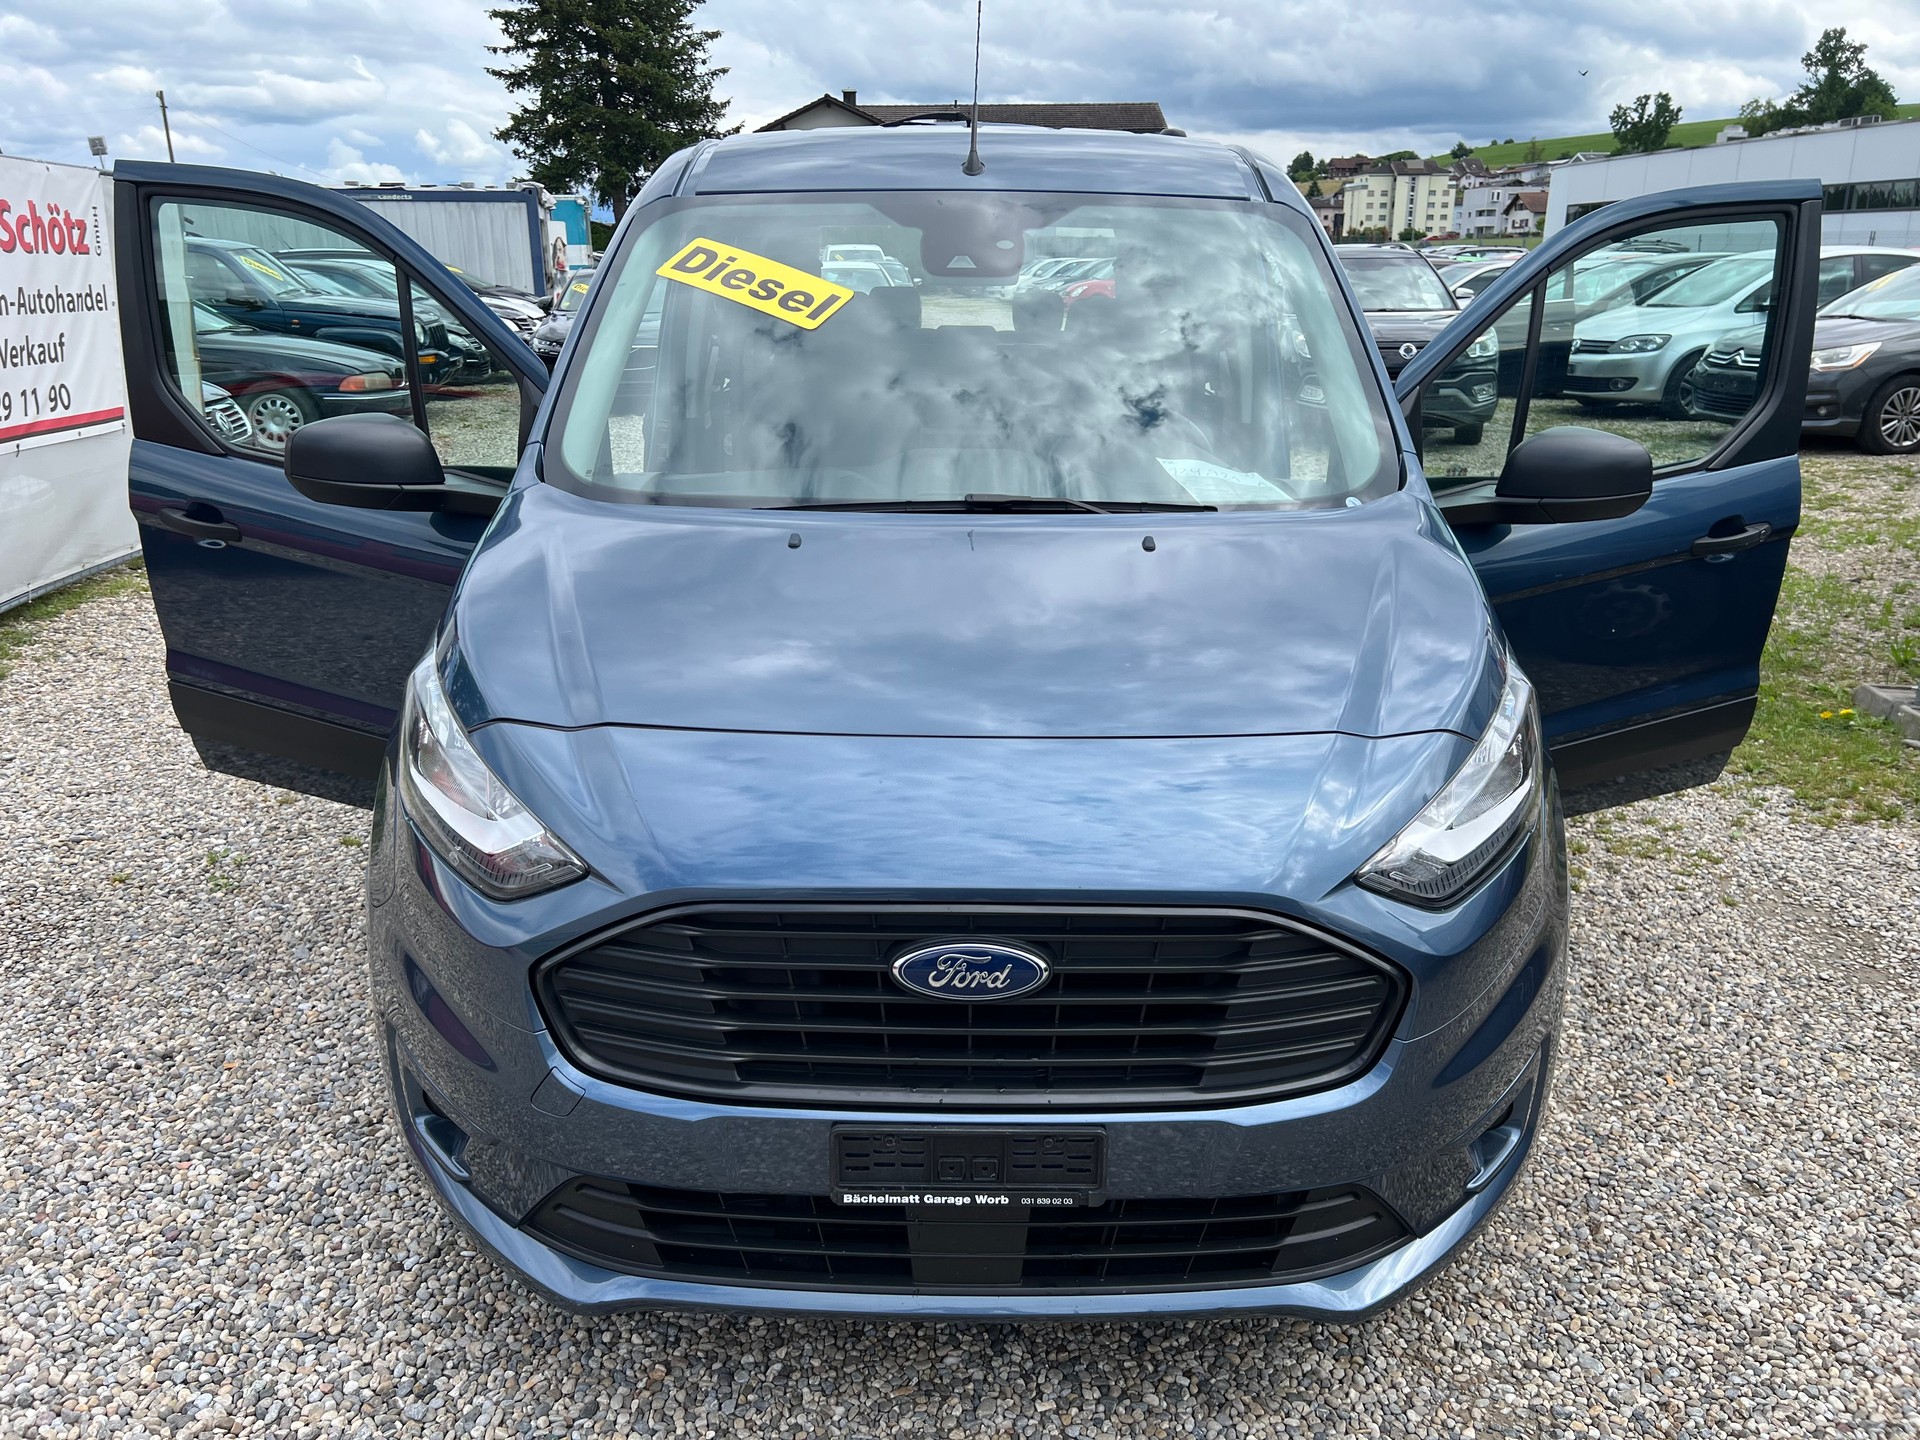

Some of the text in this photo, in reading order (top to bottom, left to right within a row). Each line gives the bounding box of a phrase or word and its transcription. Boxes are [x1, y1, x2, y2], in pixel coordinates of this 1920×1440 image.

[0, 199, 90, 255] Schötz
[92, 206, 102, 256] GmbH
[670, 246, 842, 321] Diesel
[20, 388, 40, 417] 11
[48, 383, 71, 413] 90
[928, 953, 1013, 988] Ford
[843, 1194, 1073, 1206] Bächelmatt Garage Worb 031 839 02 03
